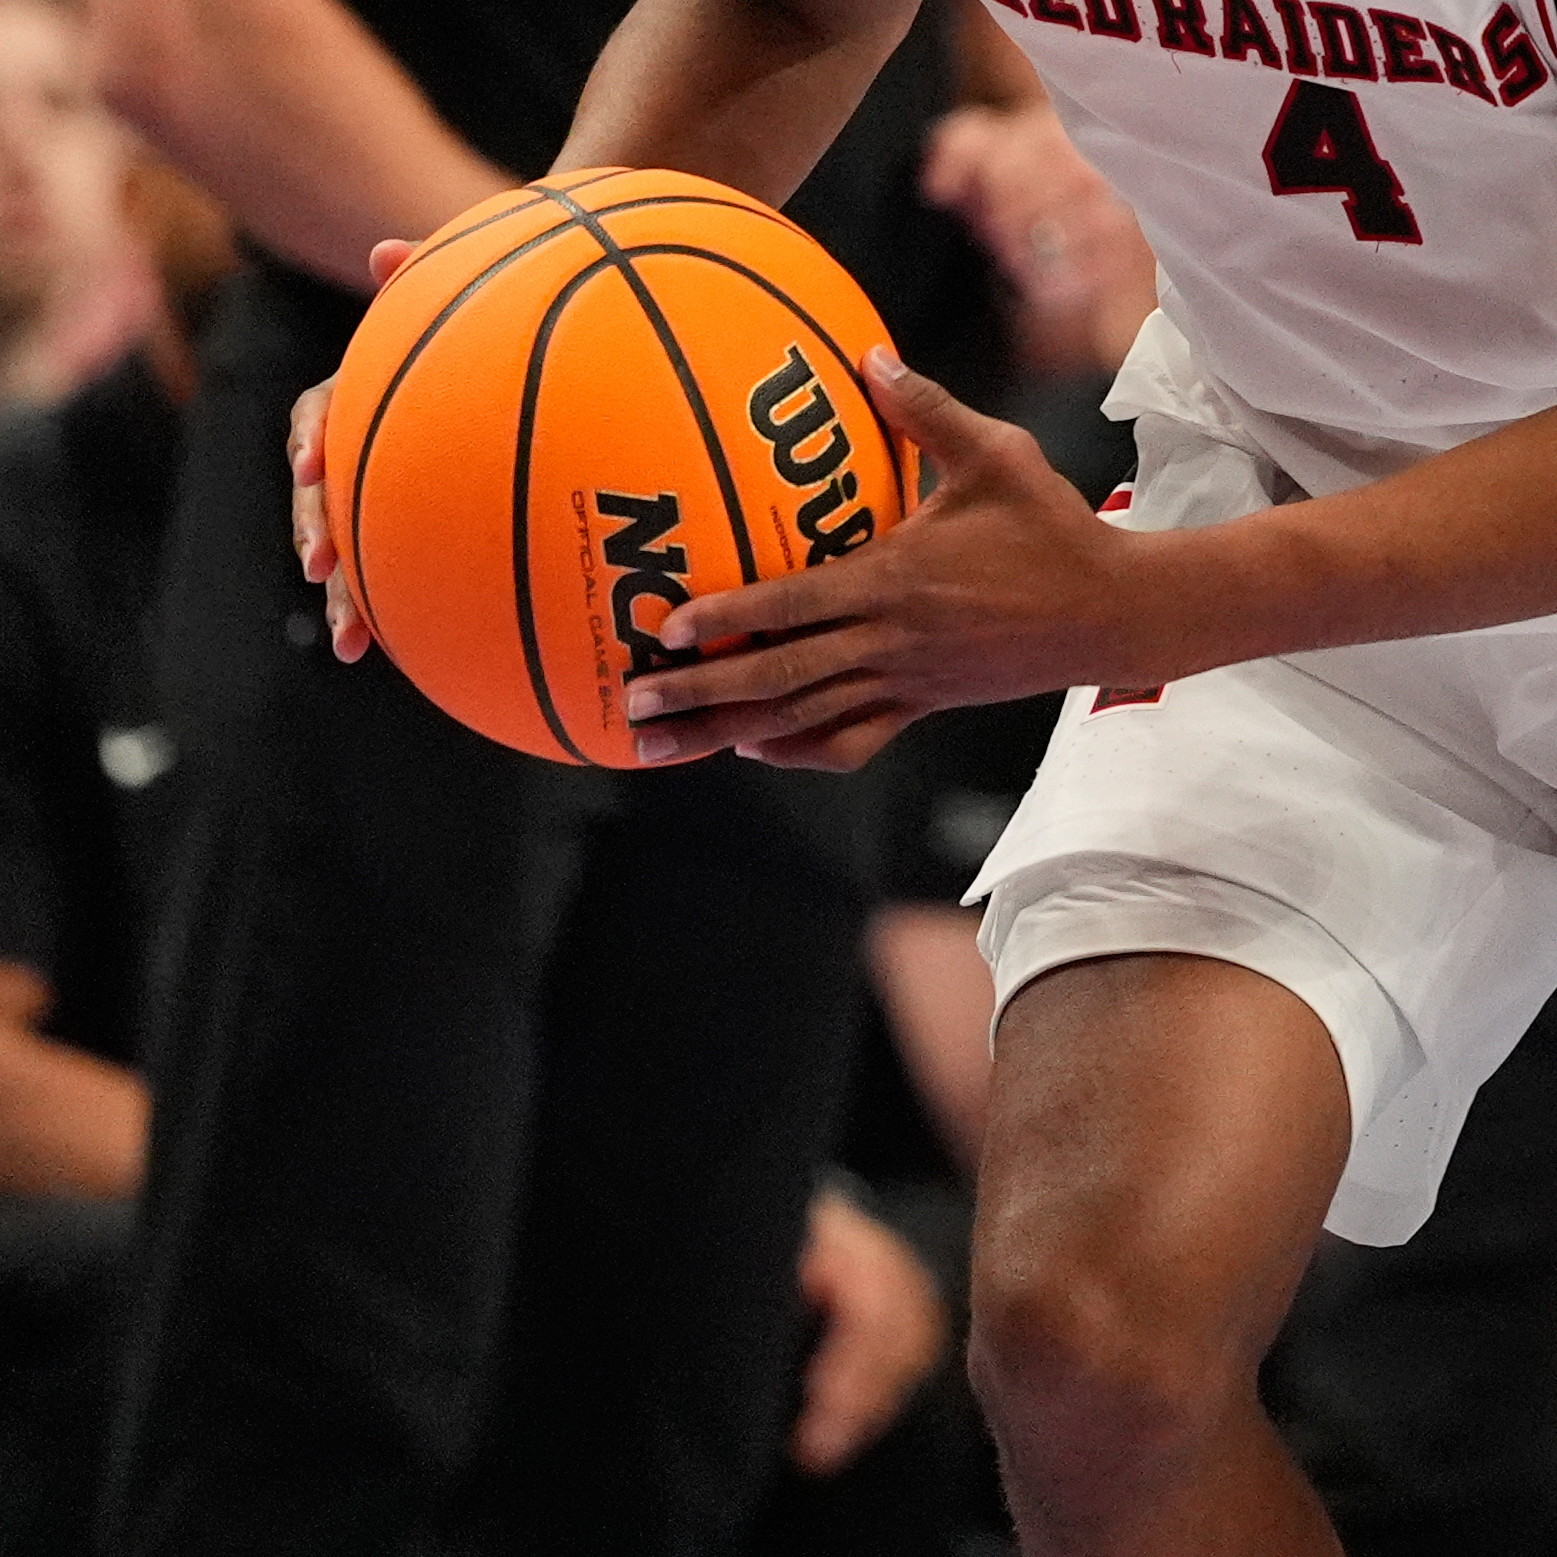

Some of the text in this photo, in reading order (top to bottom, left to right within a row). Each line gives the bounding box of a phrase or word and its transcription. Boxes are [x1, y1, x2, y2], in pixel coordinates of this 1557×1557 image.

[1262, 76, 1423, 246] 4
[746, 341, 876, 569] Wil
[571, 489, 597, 610] OFFICIAL
